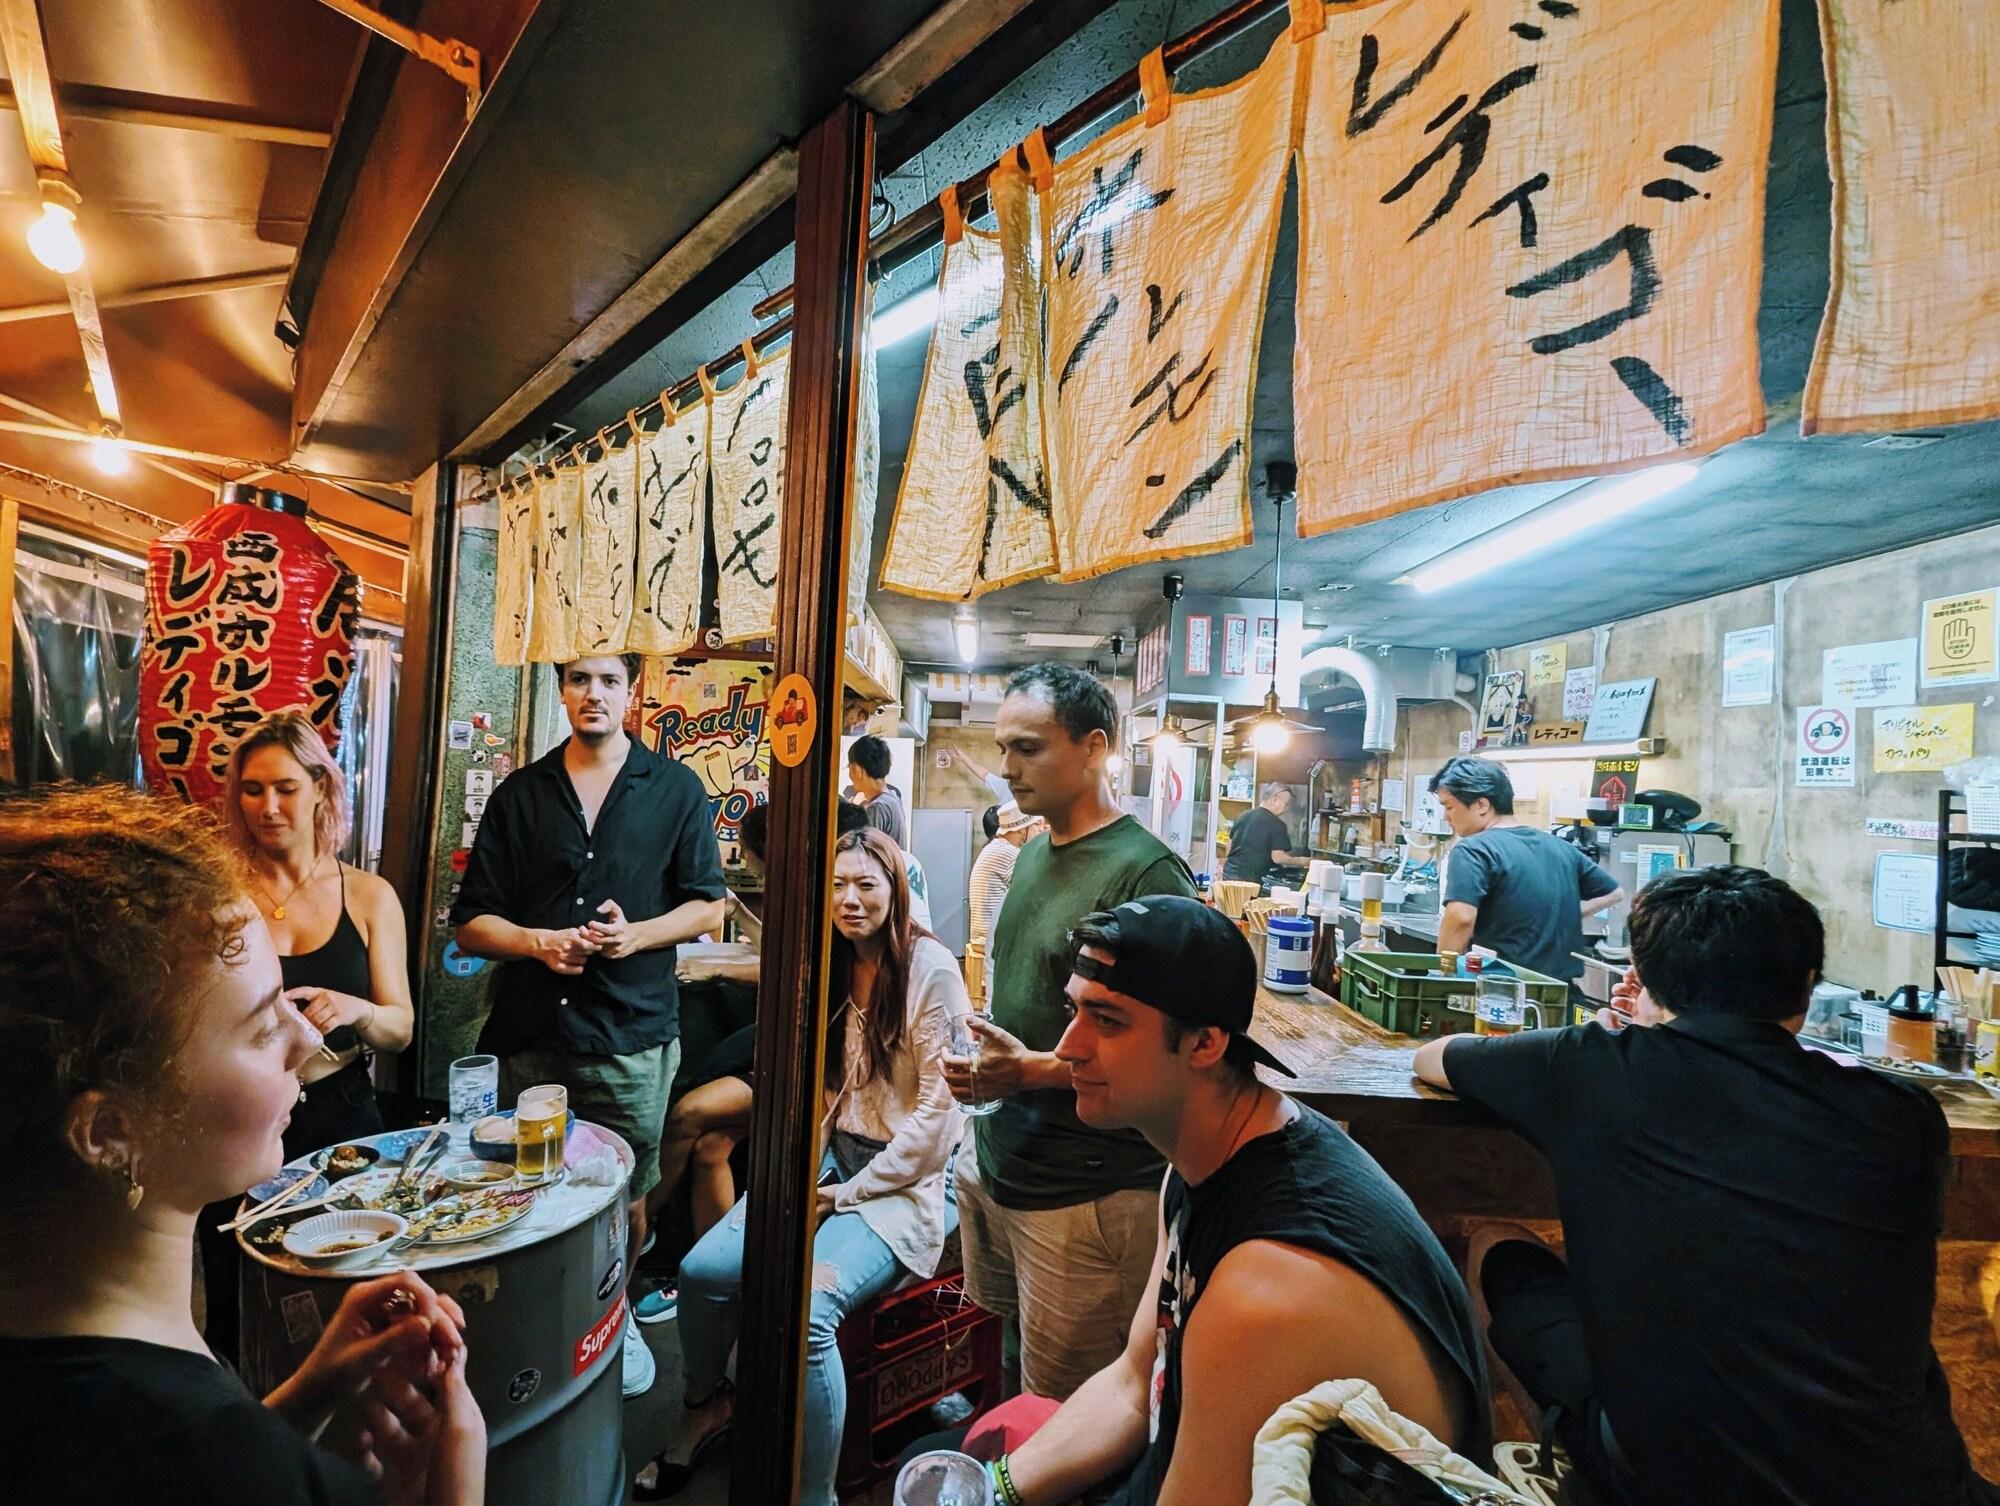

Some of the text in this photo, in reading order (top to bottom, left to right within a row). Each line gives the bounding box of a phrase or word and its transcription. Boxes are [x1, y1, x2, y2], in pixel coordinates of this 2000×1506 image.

[1534, 727, 1579, 740] レディゴー
